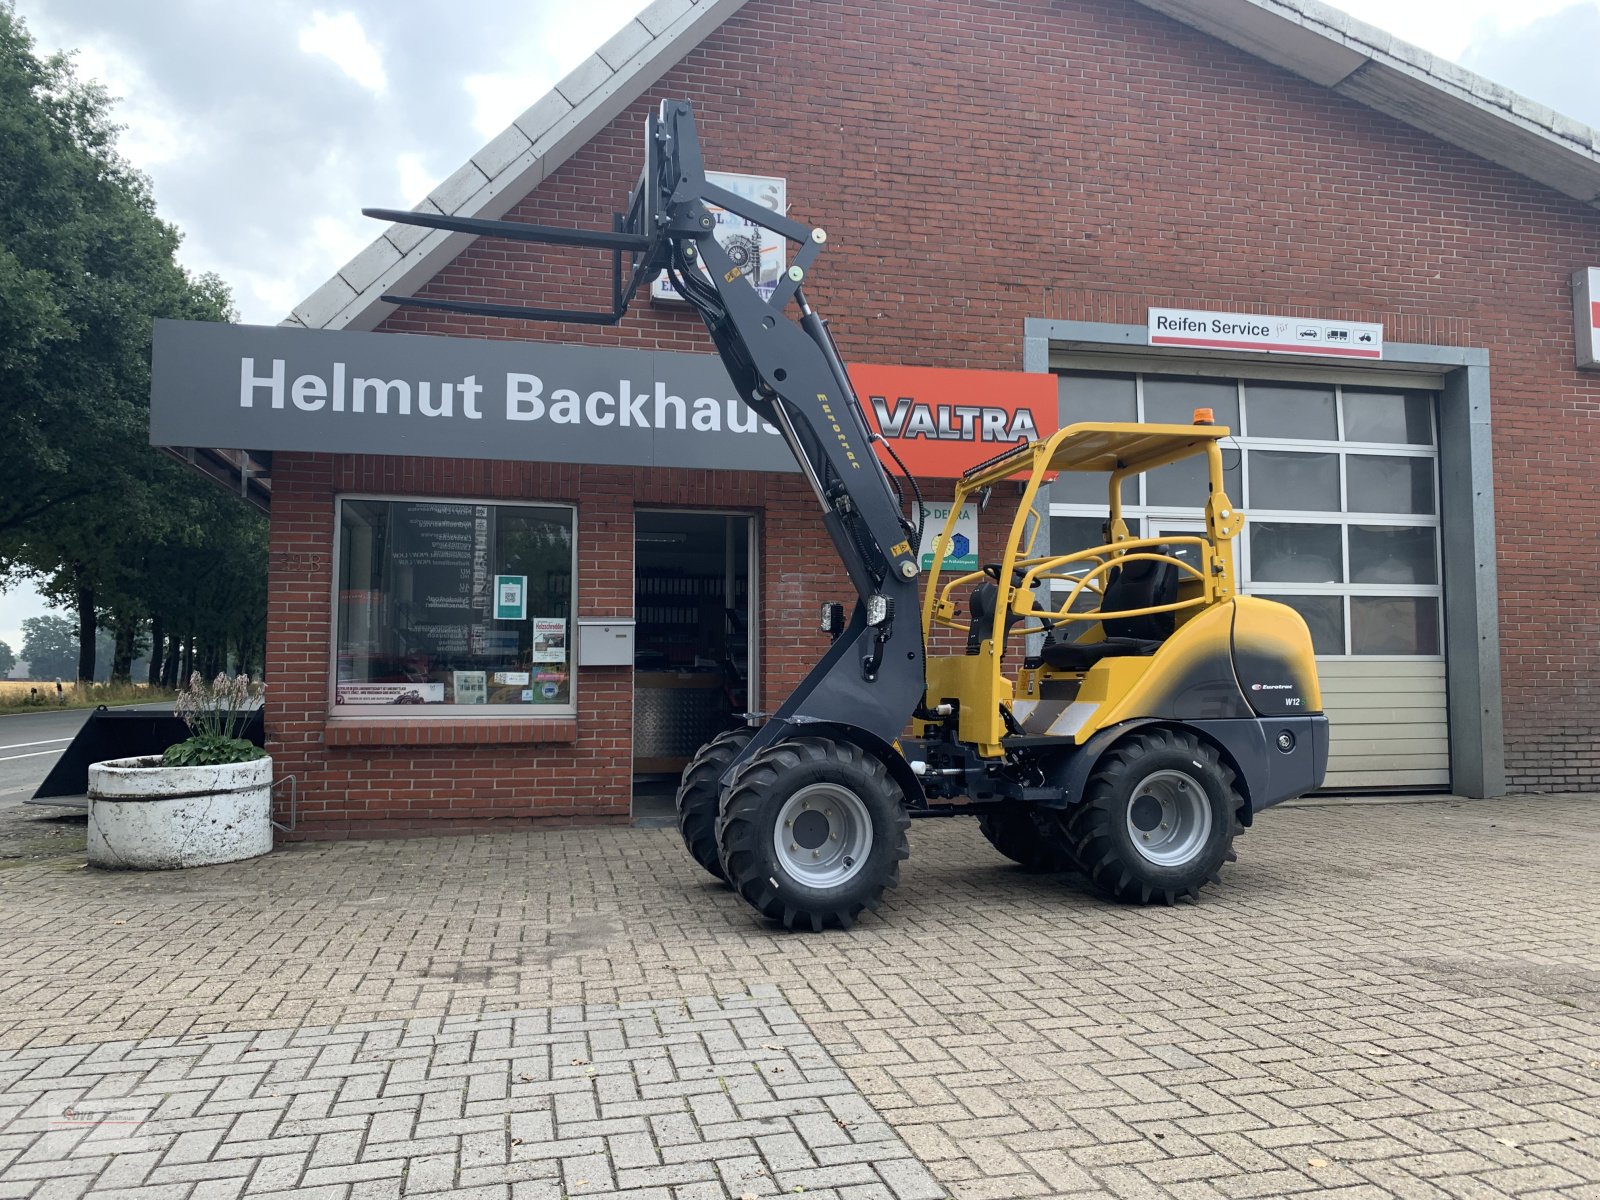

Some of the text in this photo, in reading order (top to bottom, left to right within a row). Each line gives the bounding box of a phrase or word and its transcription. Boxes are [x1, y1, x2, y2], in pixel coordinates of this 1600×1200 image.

[1157, 316, 1289, 338] Reifen Service für
[239, 357, 483, 420] Helmut
[816, 393, 860, 470] Eurotrac
[869, 395, 1040, 444] VALTRA
[934, 509, 970, 520] DERA
[1285, 698, 1300, 706] W12
